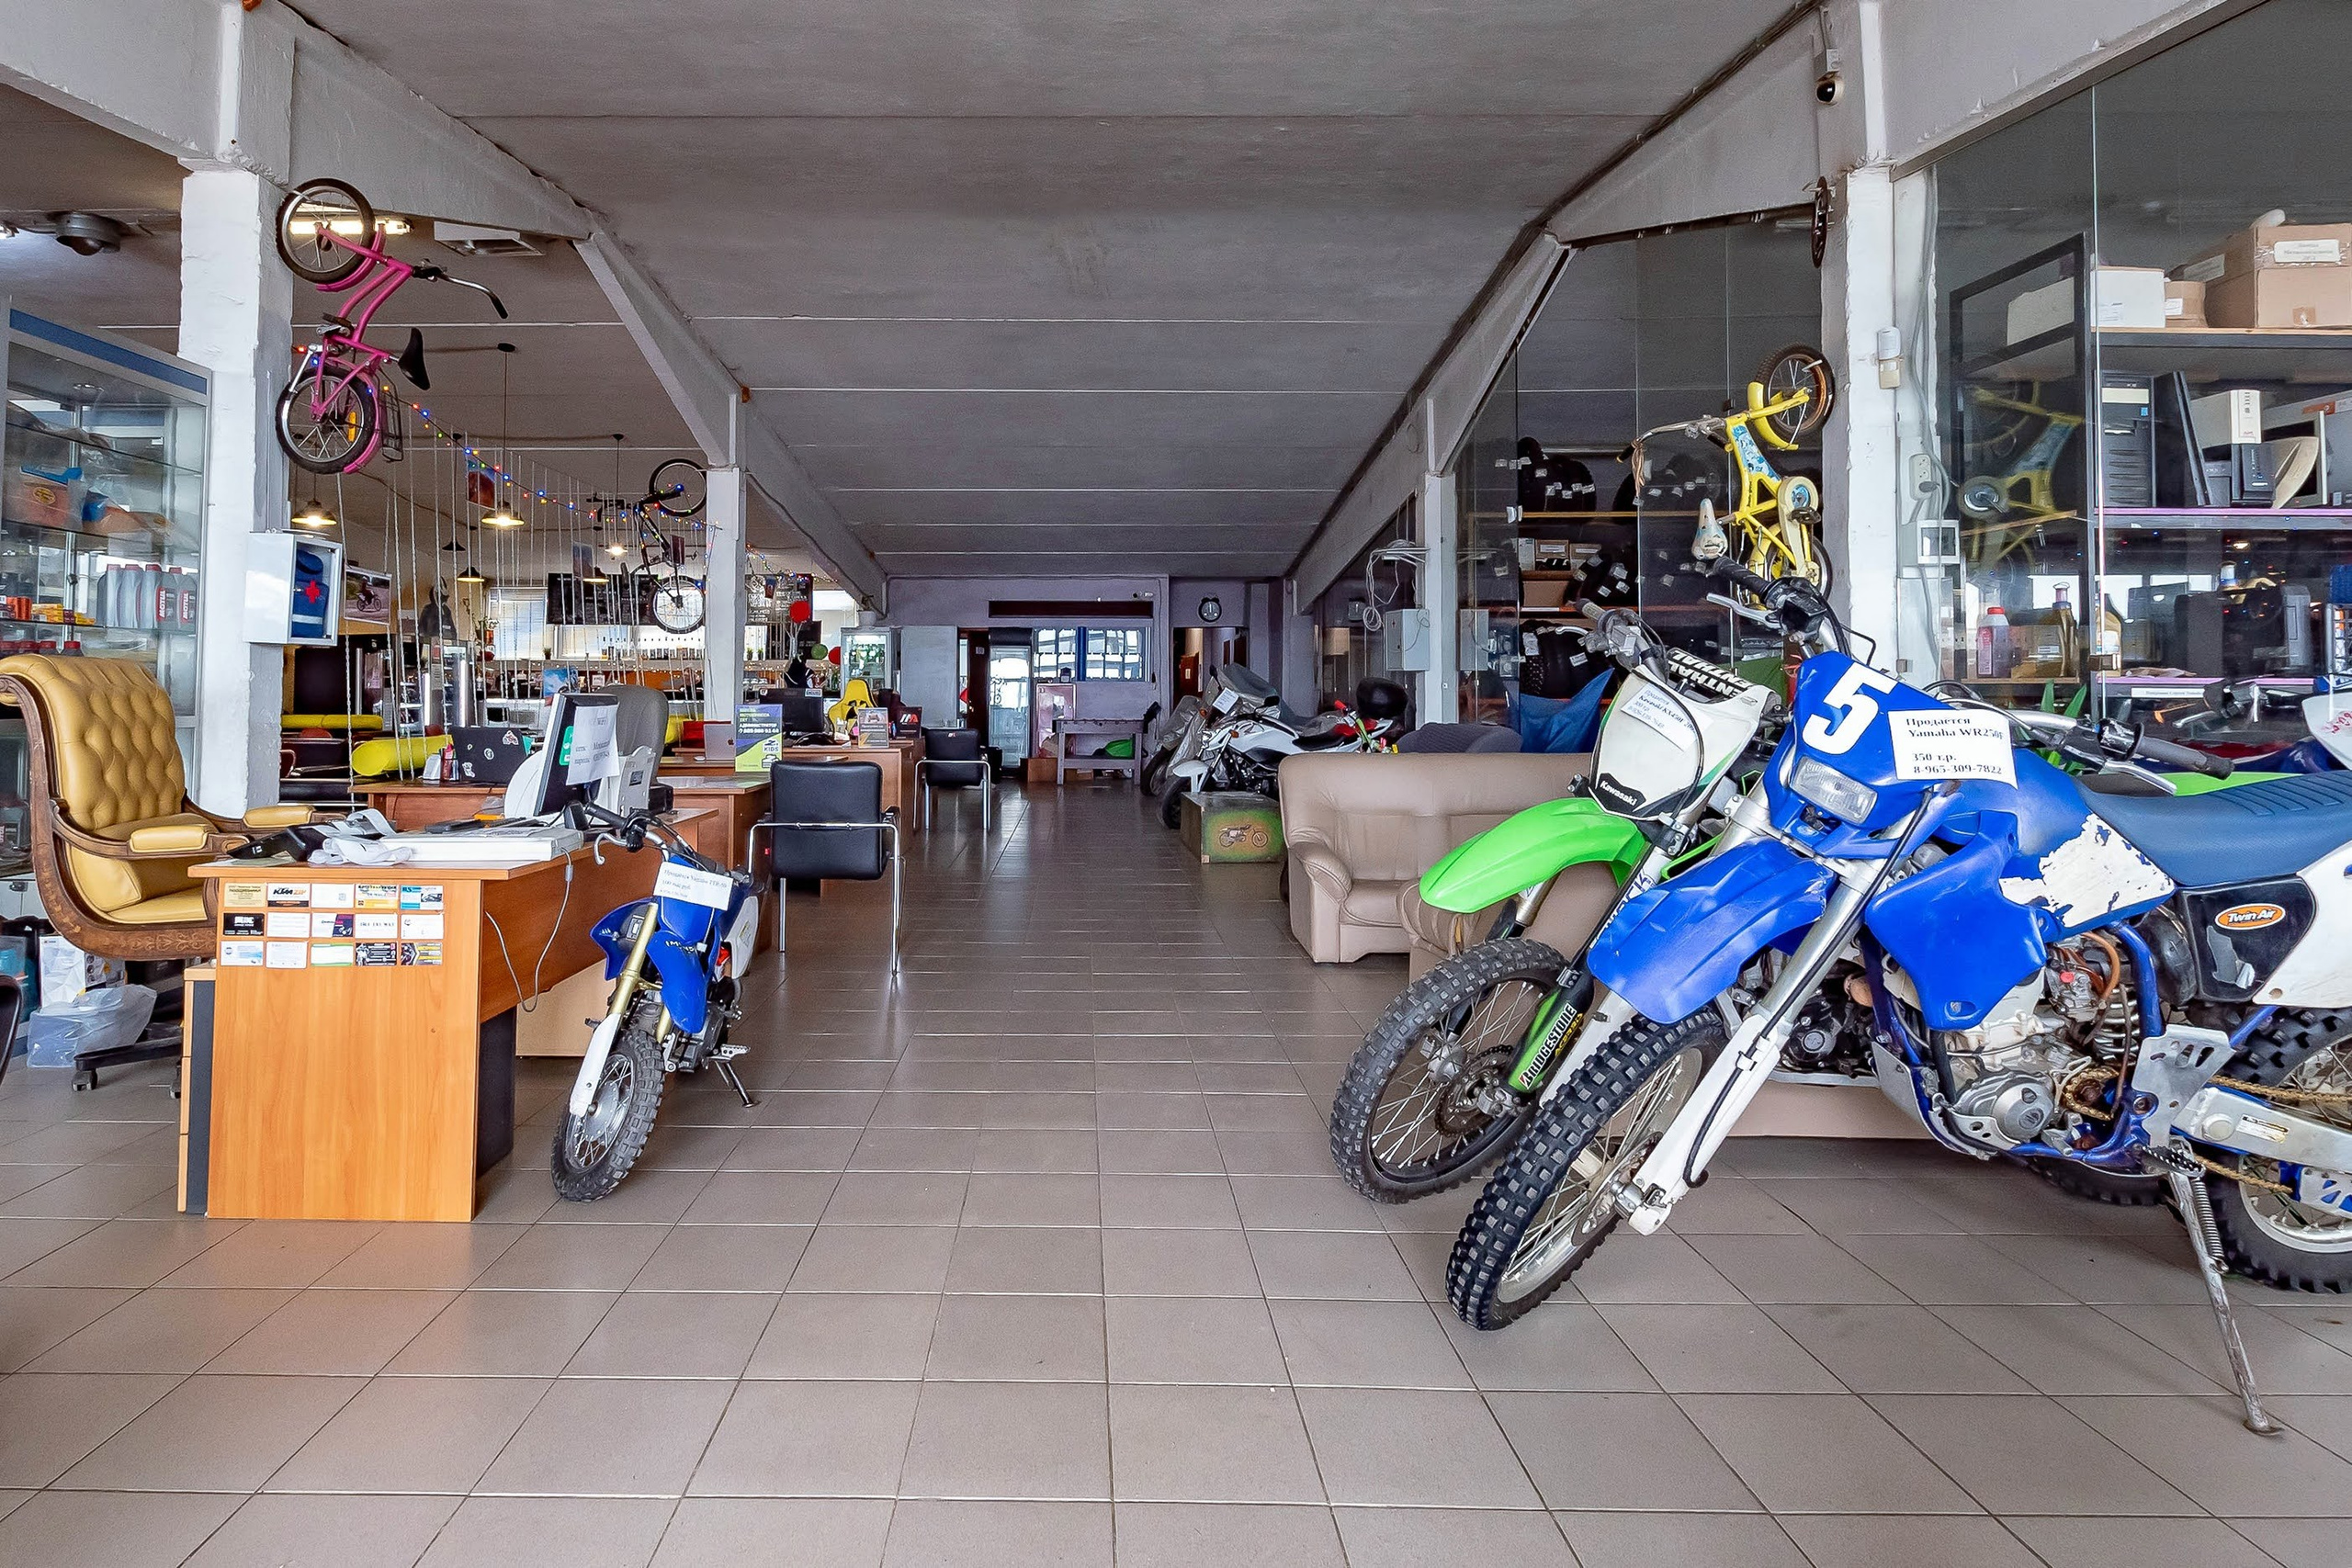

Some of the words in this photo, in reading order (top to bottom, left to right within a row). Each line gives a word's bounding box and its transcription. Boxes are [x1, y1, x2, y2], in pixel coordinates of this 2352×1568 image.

[158, 590, 166, 618] MOTUL
[1668, 660, 1744, 698] ENTHAL
[1672, 649, 1755, 690] ENTHAL
[1802, 661, 1899, 755] 5
[1908, 728, 1956, 738] Yamaha
[1912, 753, 1932, 761] 350
[1913, 764, 2003, 774] 8-965-309-7822
[1600, 780, 1638, 807] Kawasaki
[2227, 911, 2257, 923] Twin
[2256, 908, 2277, 919] Air
[1519, 1002, 1578, 1090] BRIDGESTONE
